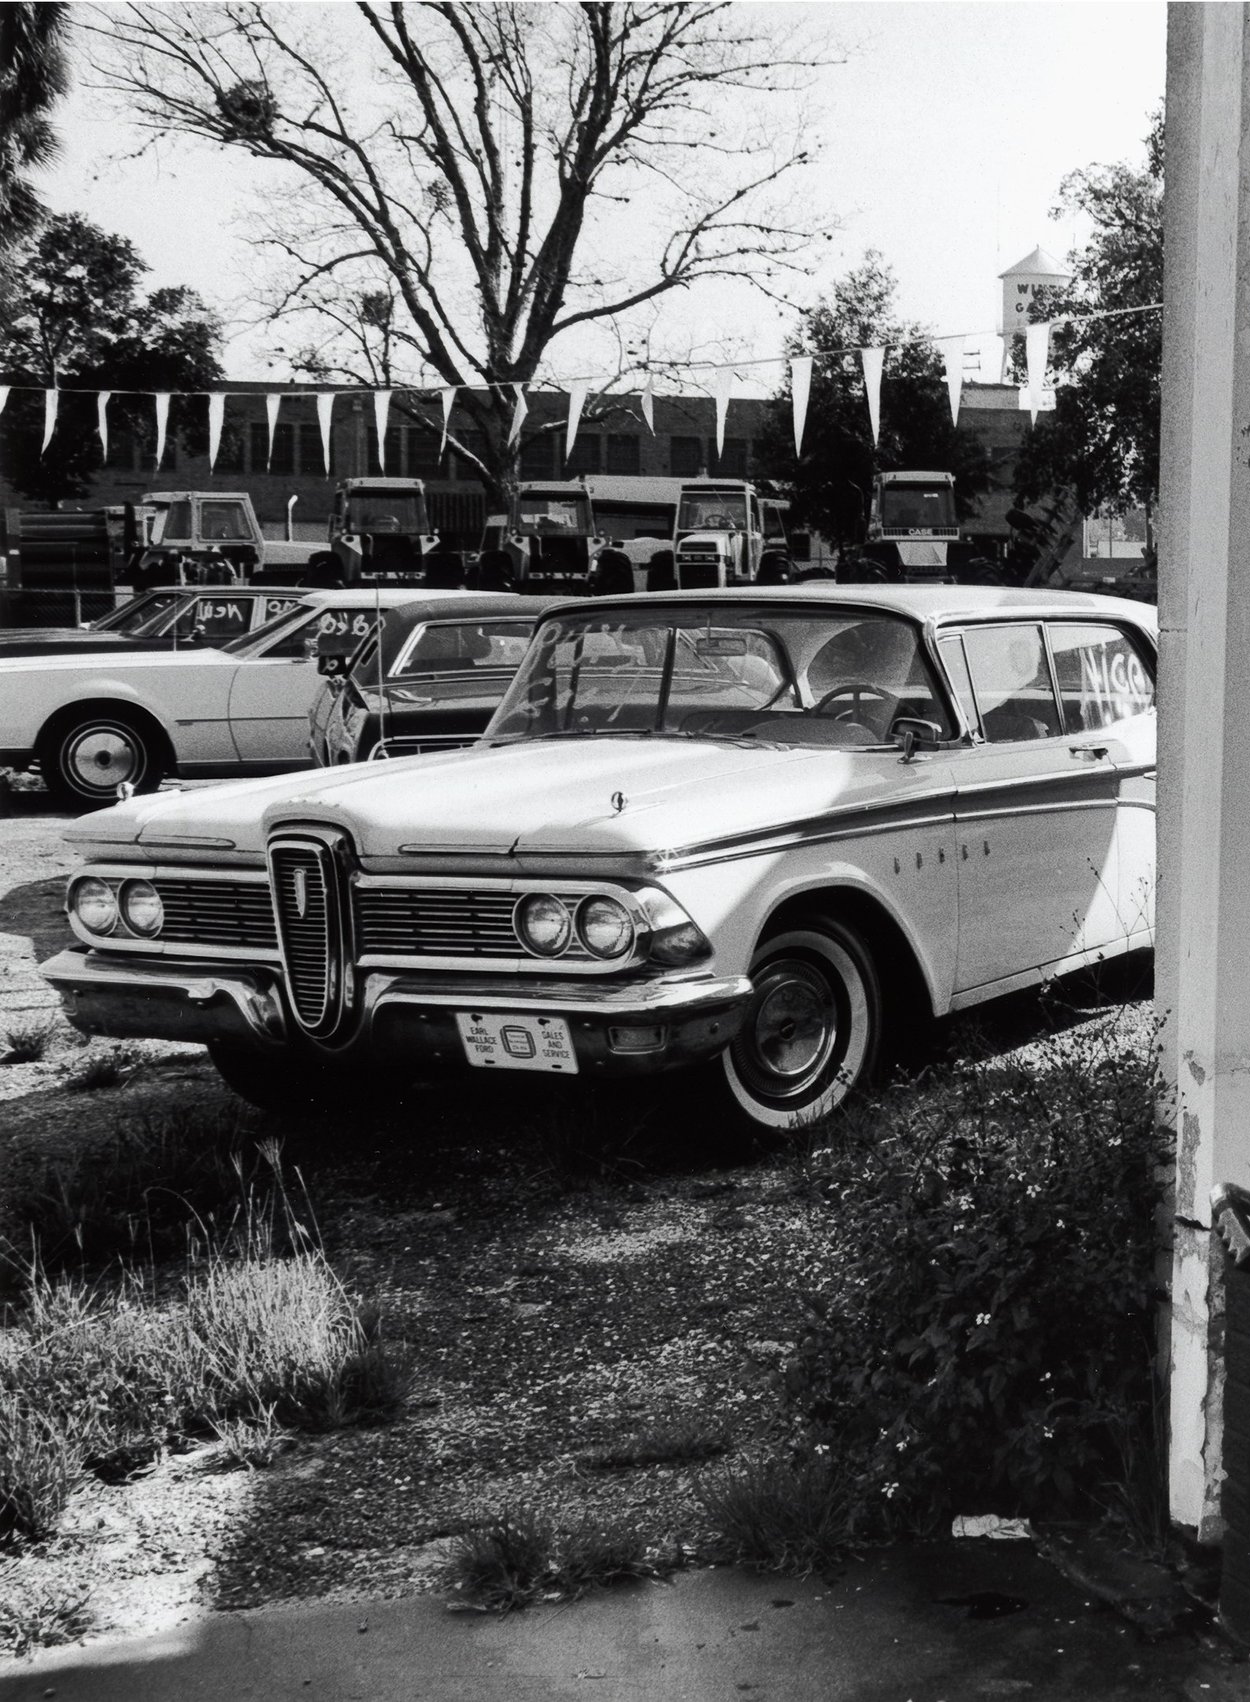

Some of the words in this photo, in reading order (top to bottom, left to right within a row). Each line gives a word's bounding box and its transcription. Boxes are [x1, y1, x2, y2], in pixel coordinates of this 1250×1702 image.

[908, 528, 933, 536] CASE
[470, 1027, 488, 1036] EARL
[541, 1031, 564, 1040] SALES
[466, 1036, 497, 1045] WALLACE
[548, 1041, 562, 1049] AND
[475, 1045, 494, 1053] FORD
[542, 1049, 570, 1058] SERVICE
